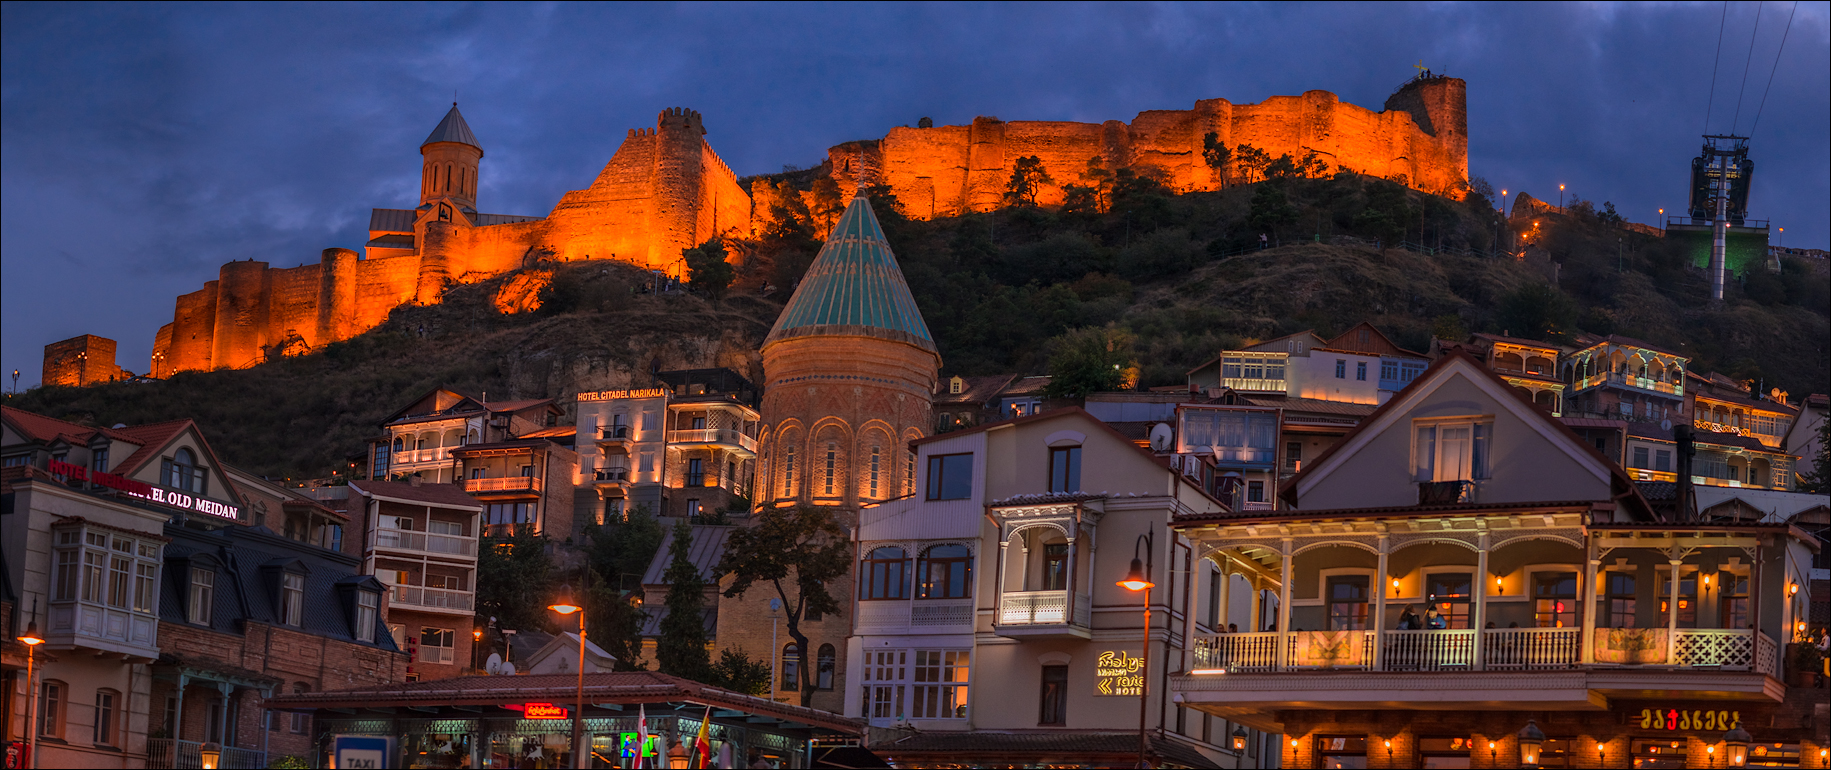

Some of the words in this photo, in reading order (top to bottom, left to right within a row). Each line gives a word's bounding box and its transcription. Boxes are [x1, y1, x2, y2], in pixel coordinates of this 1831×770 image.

[577, 391, 600, 401] HOTEL
[601, 390, 629, 400] CITADEL
[630, 388, 664, 399] NARIKALA
[48, 459, 90, 482] HOTEL
[168, 491, 192, 509] OLD
[195, 498, 237, 520] MEIDAN
[1116, 687, 1141, 695] HOTE
[347, 757, 375, 769] TAXI
